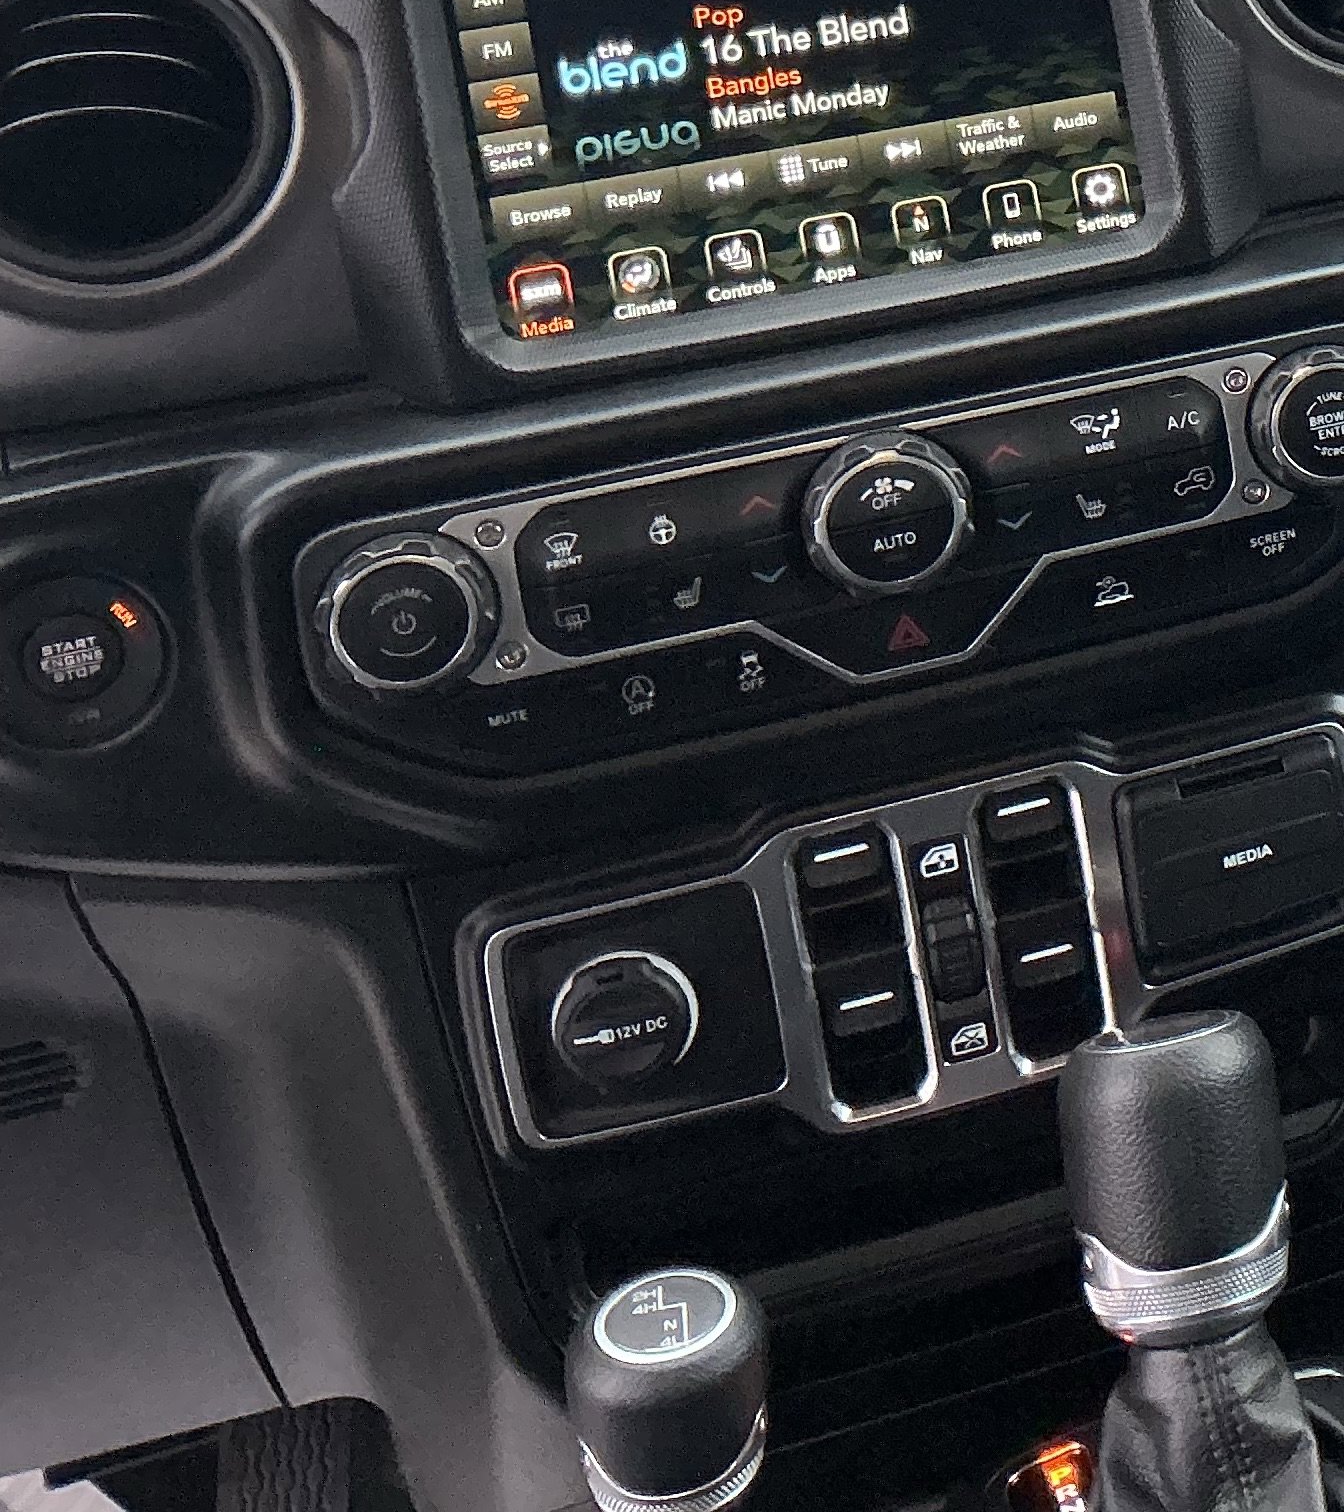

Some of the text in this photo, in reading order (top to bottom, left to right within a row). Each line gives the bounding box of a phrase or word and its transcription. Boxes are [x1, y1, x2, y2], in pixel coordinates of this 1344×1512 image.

[693, 6, 745, 29] Pop
[700, 3, 911, 66] 16 The Blend
[482, 40, 513, 60] FM
[597, 39, 634, 60] the
[557, 39, 689, 95] blend
[706, 66, 803, 99] Bangles
[710, 82, 890, 131] Manic Monday
[956, 118, 1006, 138] Traffic
[1053, 111, 1099, 133] Audio
[482, 140, 534, 158] Source
[958, 133, 1026, 156] Weather
[489, 156, 535, 174] Select
[806, 154, 849, 174] Tune
[605, 187, 664, 210] Replay
[509, 205, 574, 227] Browse
[1076, 210, 1138, 235] Settings
[991, 229, 1043, 251] Phone
[910, 246, 945, 266] Nav
[814, 263, 857, 285] Apps
[706, 277, 778, 304] Controls
[613, 296, 679, 321] Climate
[521, 315, 575, 338] Media
[1316, 391, 1344, 406] TUNE
[1167, 410, 1201, 431] A/C
[871, 491, 903, 511] OFF
[873, 530, 917, 553] AUTO
[1249, 527, 1297, 549] SCREEN
[1261, 542, 1286, 558] OFF
[545, 553, 584, 571] FRONT
[109, 601, 138, 629] RUN
[41, 635, 98, 657] START
[40, 648, 105, 672] ENGINE
[53, 665, 102, 684] STOP
[739, 676, 767, 692] OFF
[488, 708, 529, 728] MUTE
[628, 700, 655, 716] OFF
[1222, 843, 1274, 869] MEDIA
[615, 1016, 669, 1041] 12V DC
[631, 1301, 658, 1316] 4H
[663, 1318, 678, 1333] N
[1049, 1464, 1074, 1488] P
